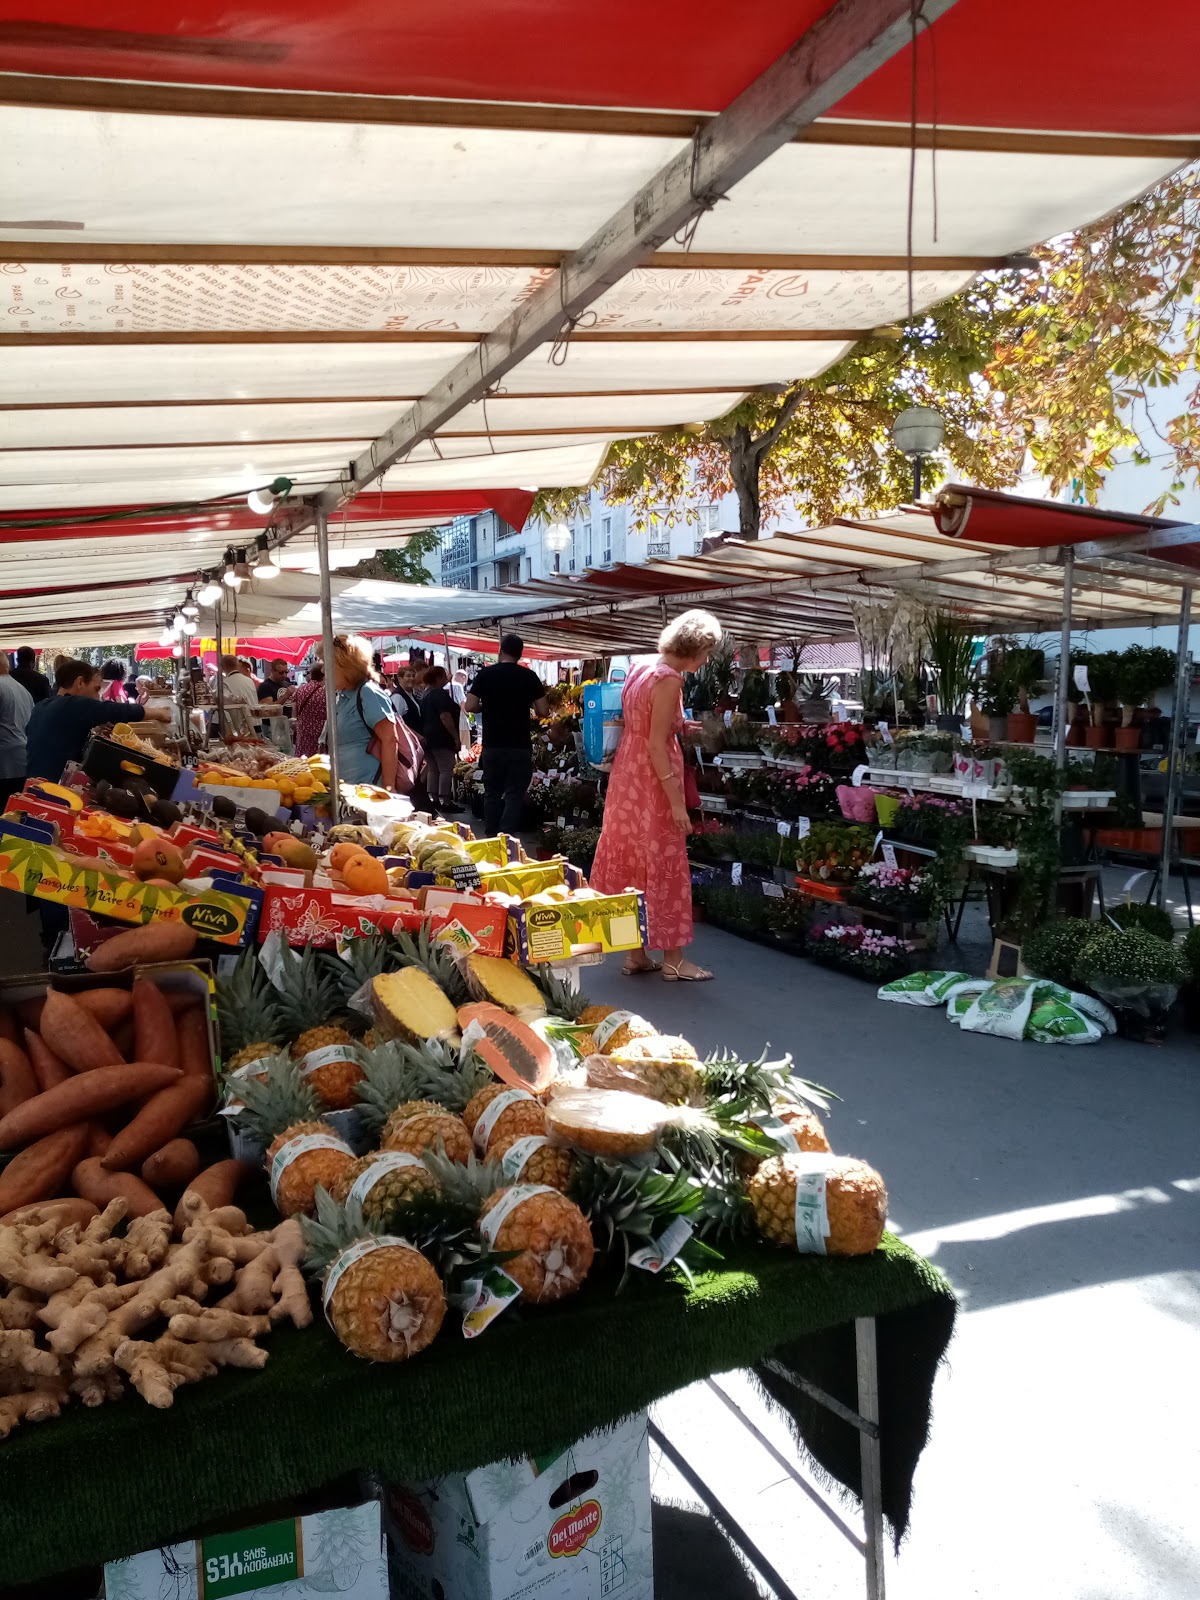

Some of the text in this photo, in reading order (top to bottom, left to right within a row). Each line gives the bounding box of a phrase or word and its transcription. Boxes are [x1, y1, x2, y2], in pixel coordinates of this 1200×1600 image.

[161, 268, 194, 287] PARIS
[195, 272, 228, 290] PARIS
[230, 275, 260, 293] PARIS
[298, 269, 327, 287] PARIS
[329, 272, 358, 290] PARIS
[361, 275, 388, 293] PARIS
[394, 272, 407, 289] PARIS
[470, 272, 483, 289] PARIS
[11, 284, 23, 302] PARIS
[114, 284, 124, 301] PARIS
[161, 283, 193, 299] PARIS
[195, 286, 226, 301] PARIS
[263, 279, 292, 296] PARIS
[295, 282, 323, 298] PARIS
[326, 285, 354, 300] PARIS
[357, 288, 383, 302] PARIS
[228, 289, 258, 303] PARIS
[261, 292, 289, 305] PARIS
[451, 864, 477, 874] ananas
[455, 880, 468, 889] kilo
[27, 868, 80, 892] Mangues
[139, 904, 174, 919] point
[551, 1510, 598, 1547] Del Monte
[604, 1532, 617, 1544] SIZE
[243, 1546, 266, 1562] SAYS
[602, 1547, 608, 1556] 5
[205, 1552, 244, 1583] YES
[243, 1552, 294, 1575] EVERYBODY
[603, 1560, 609, 1569] 6
[603, 1572, 609, 1581] 7
[604, 1584, 610, 1593] 8
